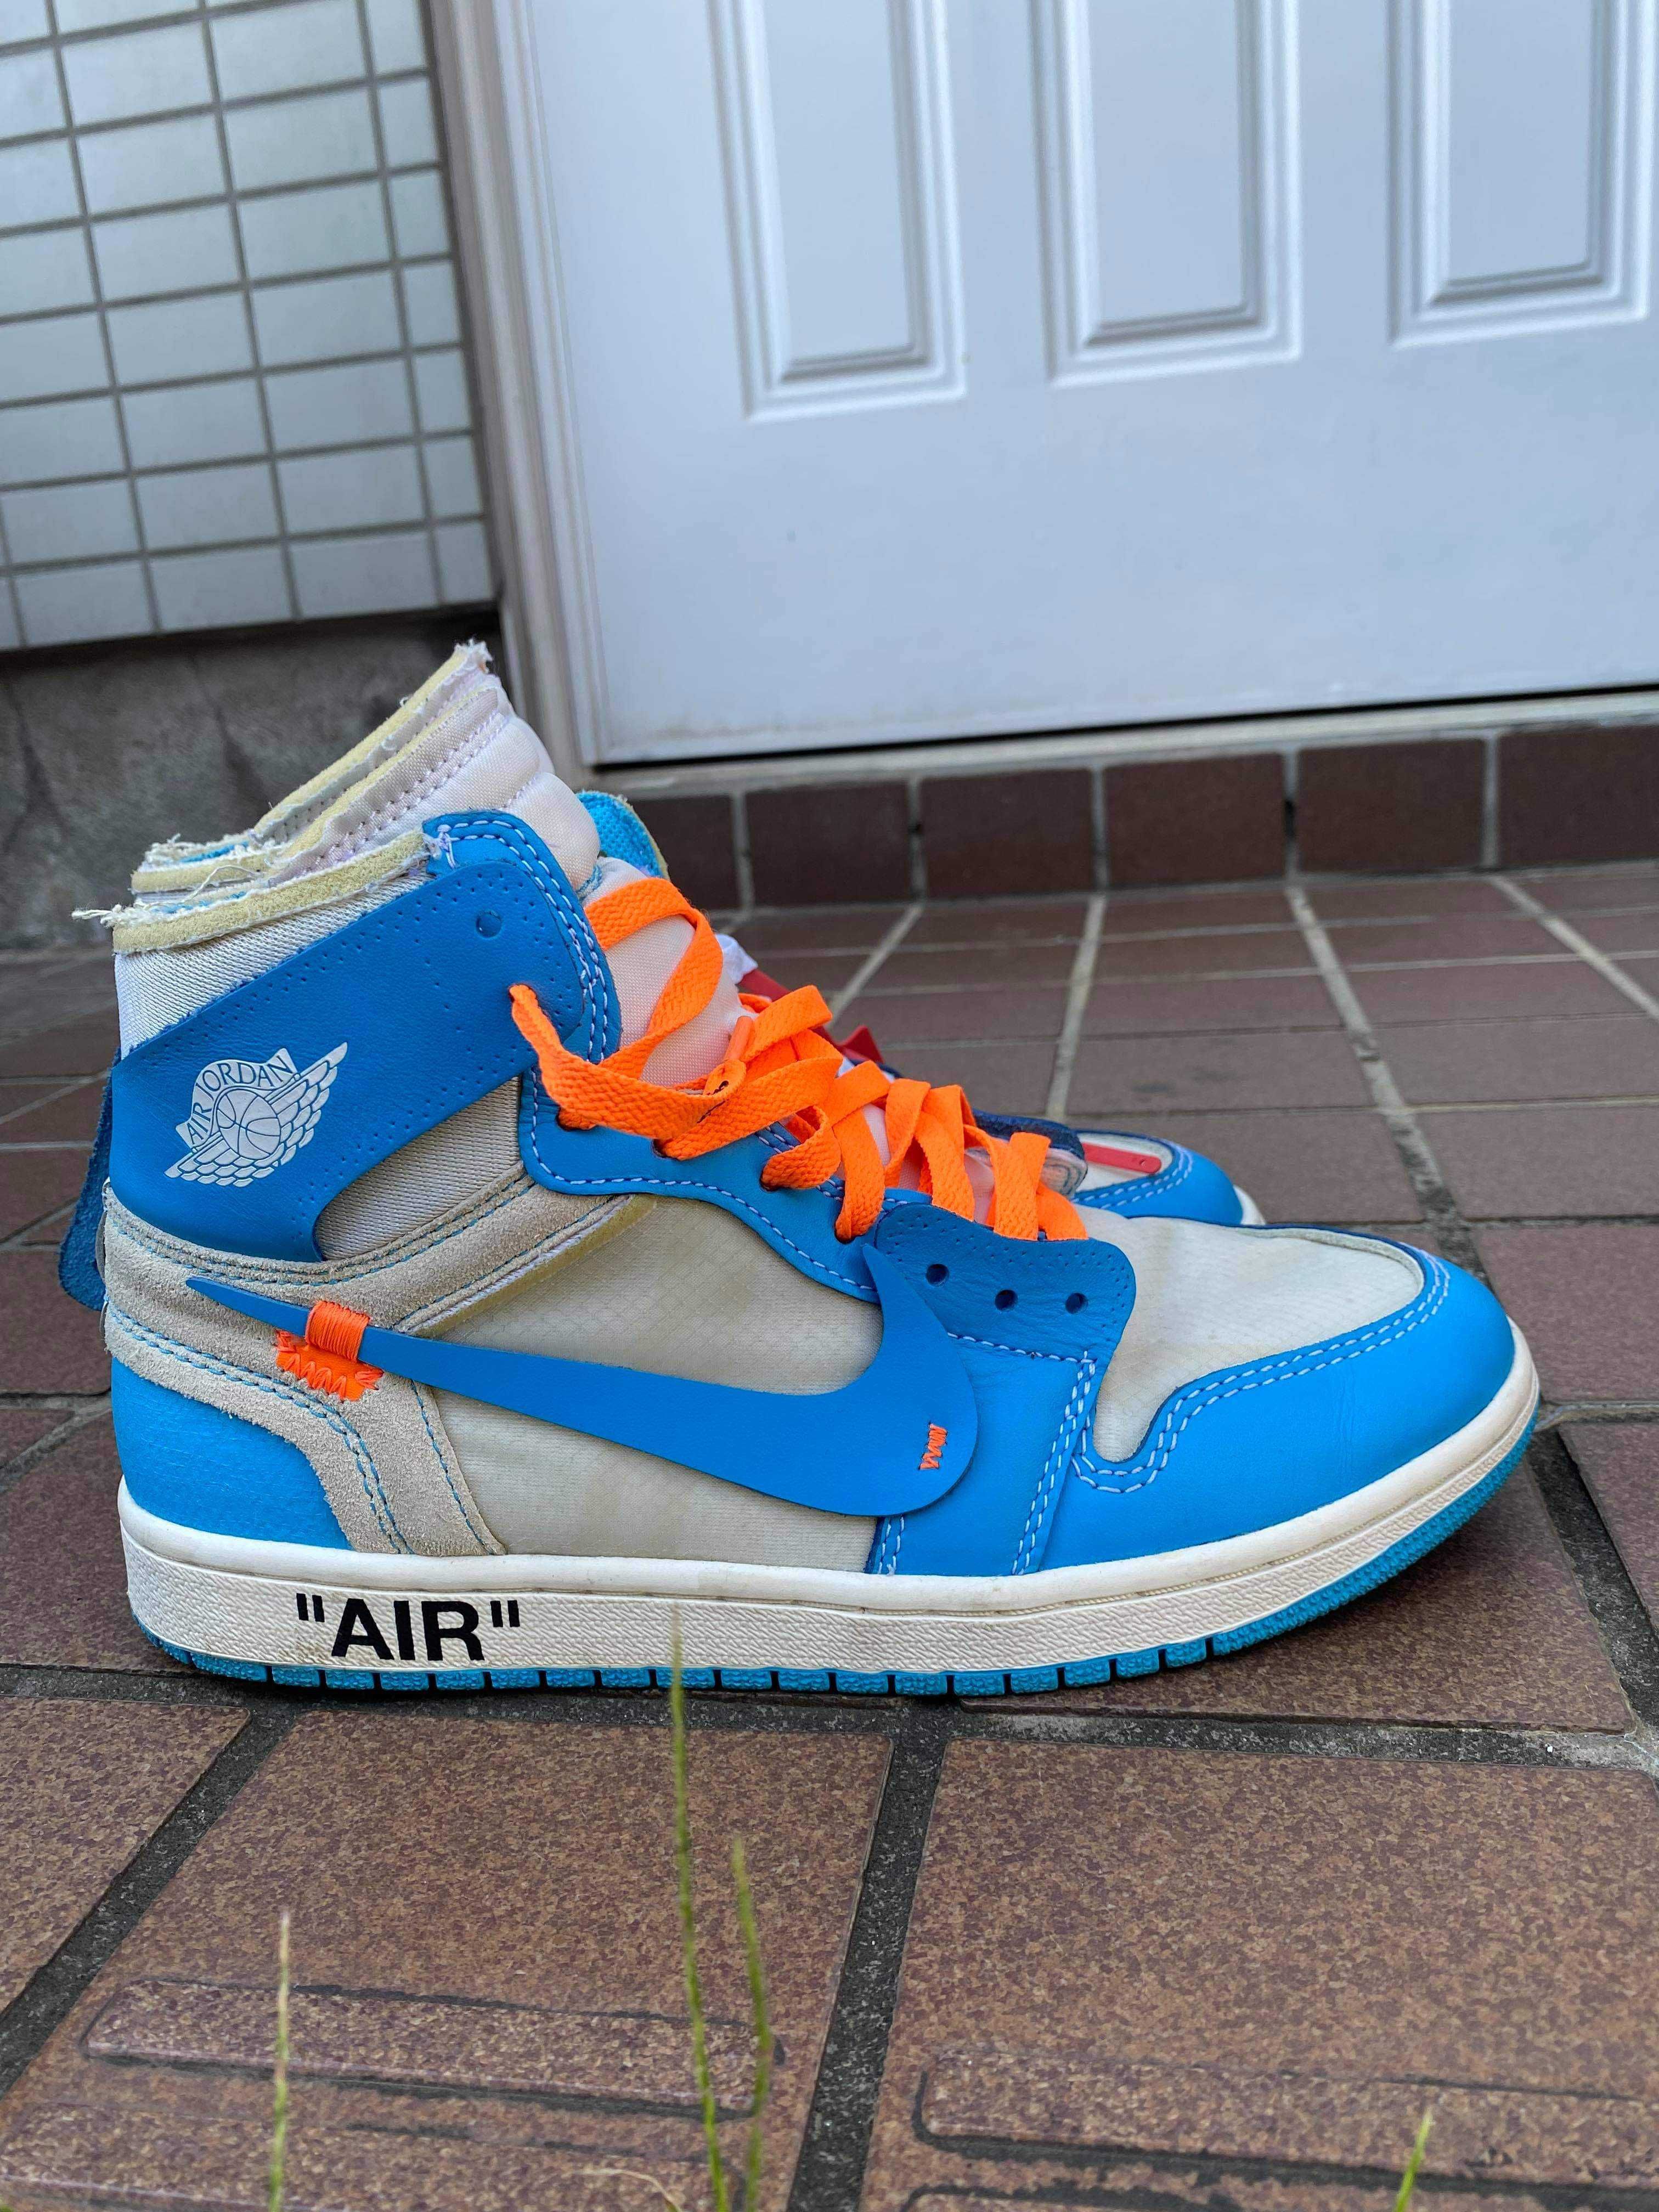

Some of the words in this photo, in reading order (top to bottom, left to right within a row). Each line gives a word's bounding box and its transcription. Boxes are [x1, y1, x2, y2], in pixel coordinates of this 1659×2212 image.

[195, 1056, 293, 1101] JORDAN
[187, 1102, 212, 1145] AIR
[296, 1593, 520, 1661] "AIR"
